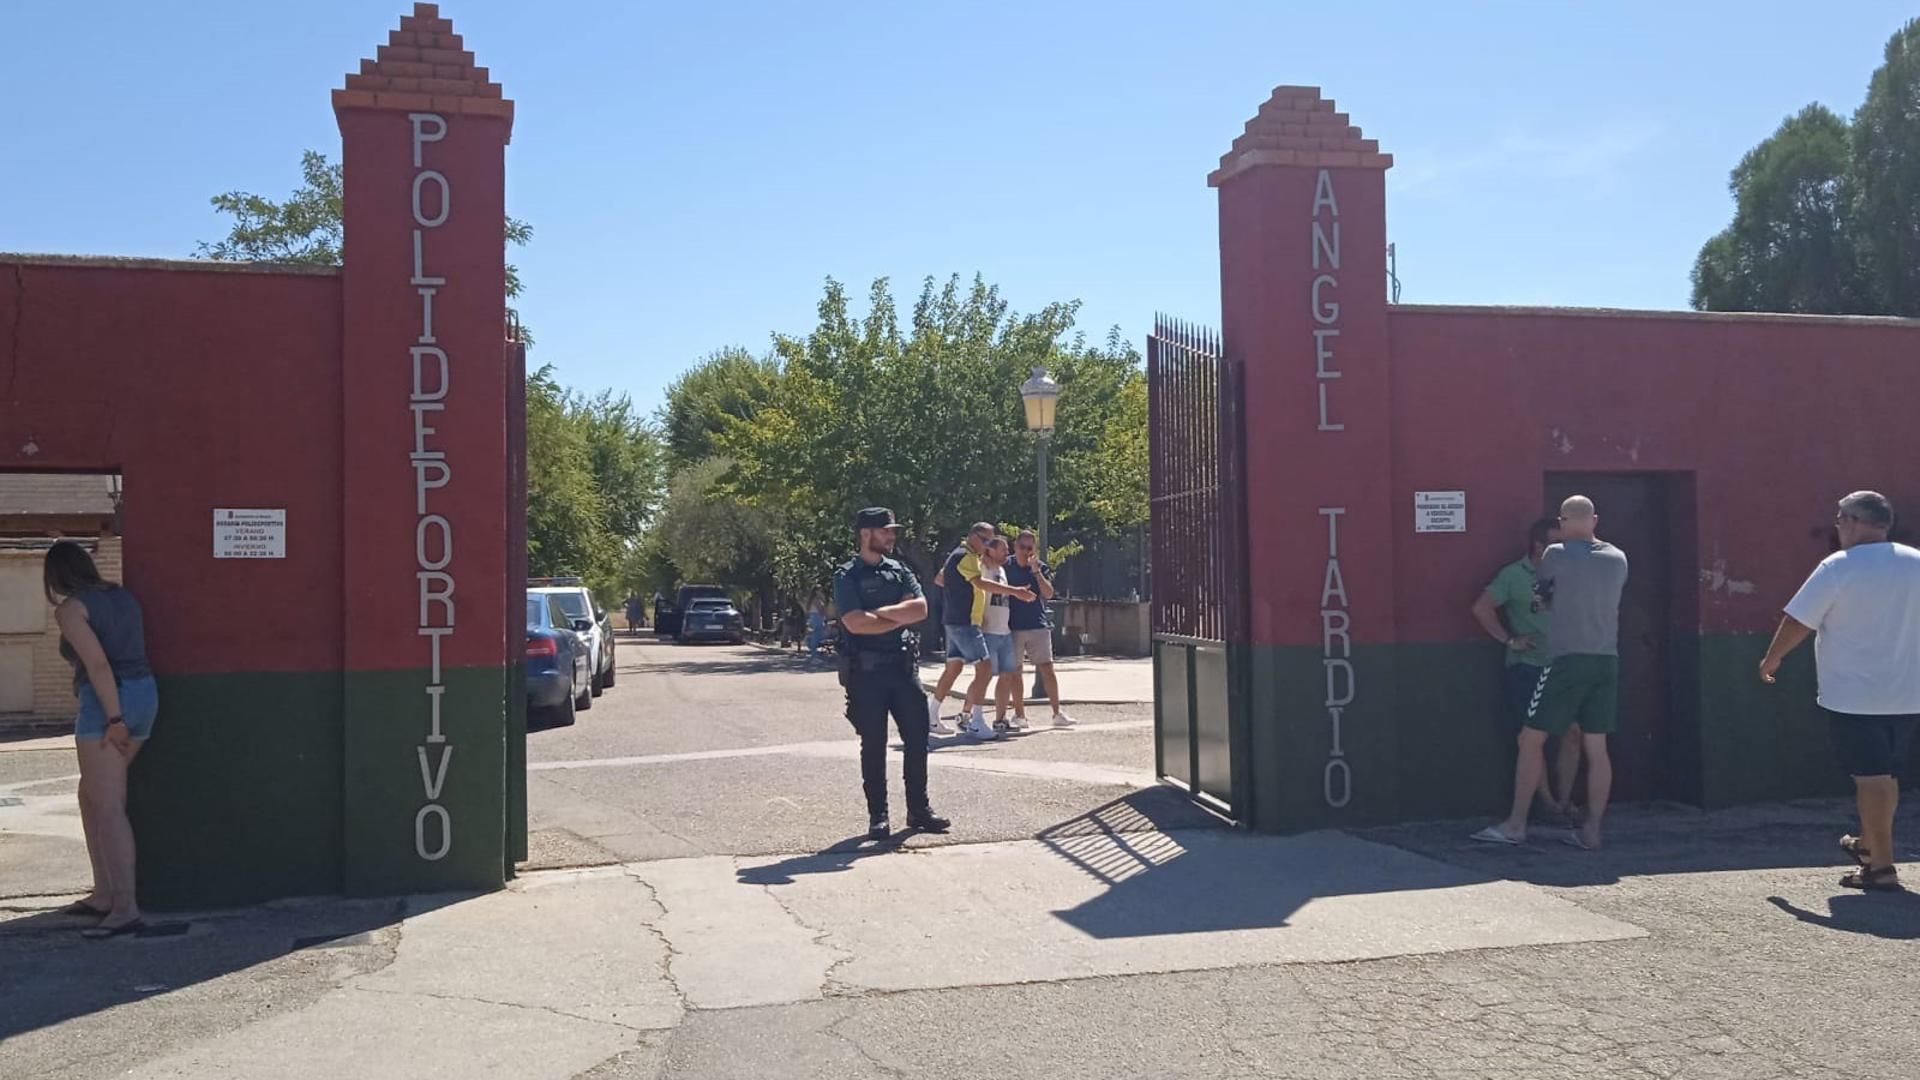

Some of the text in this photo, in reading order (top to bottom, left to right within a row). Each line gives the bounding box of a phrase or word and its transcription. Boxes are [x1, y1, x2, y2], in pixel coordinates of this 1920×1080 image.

[408, 113, 455, 861] POLIDEPORTIVO
[1312, 169, 1355, 807] ANGEL TARDIO
